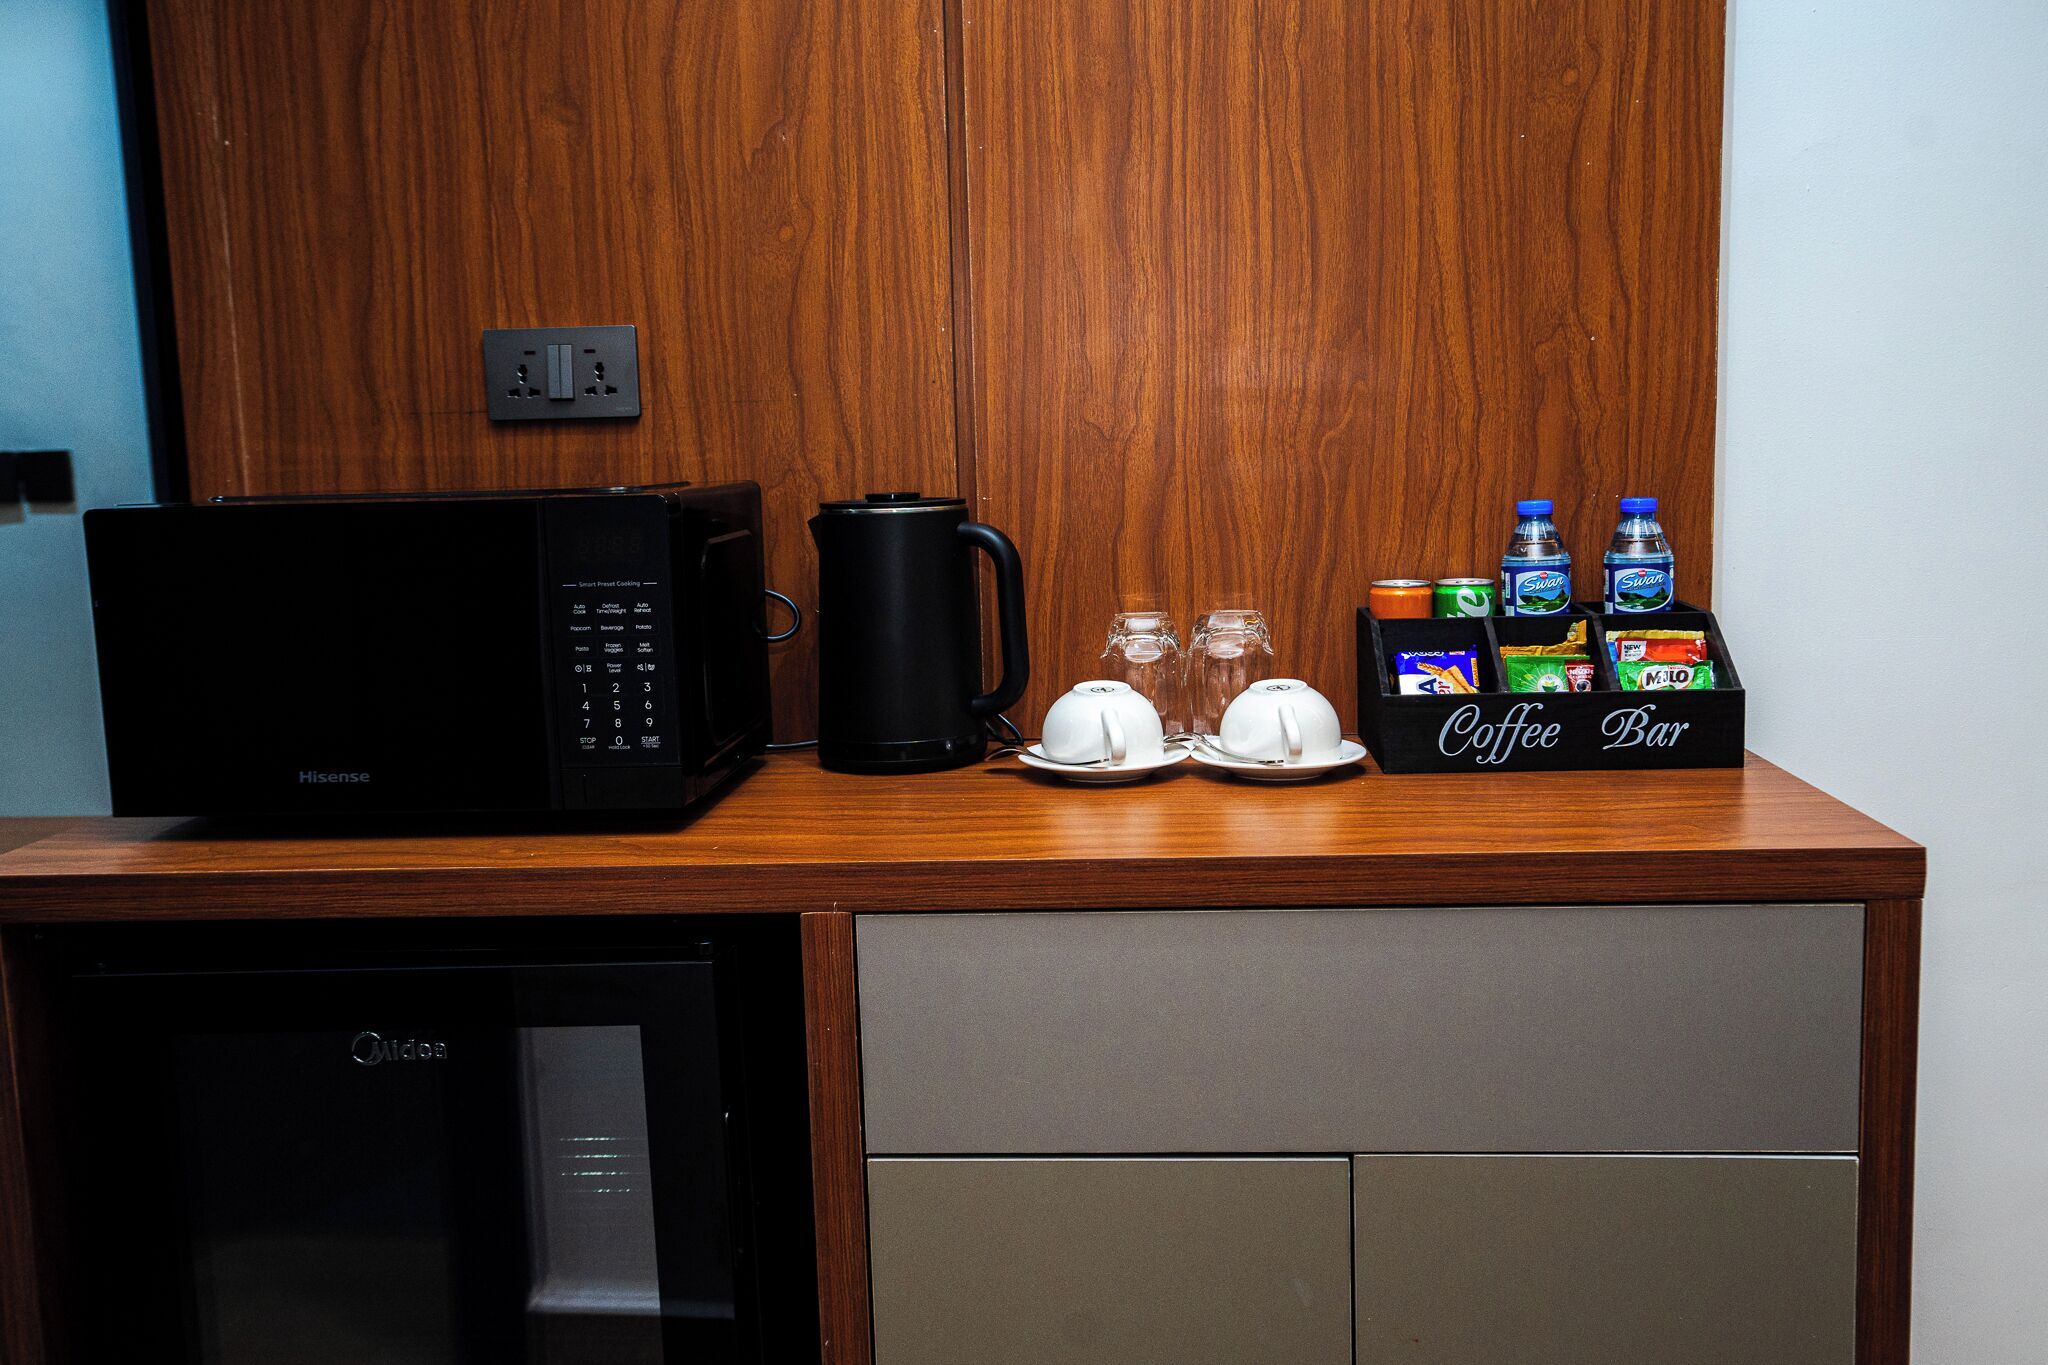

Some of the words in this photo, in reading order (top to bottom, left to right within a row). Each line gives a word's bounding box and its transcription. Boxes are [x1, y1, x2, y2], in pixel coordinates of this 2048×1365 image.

[616, 580, 640, 588] Cooking
[1523, 576, 1564, 592] Swan
[1621, 573, 1664, 589] Swan
[582, 683, 587, 693] 1
[612, 682, 620, 693] 2
[644, 682, 651, 692] 3
[582, 701, 590, 711] 4
[613, 700, 621, 710] 5
[644, 700, 652, 710] 6
[583, 719, 590, 729] 7
[615, 718, 622, 728] 8
[645, 717, 653, 728] 9
[1438, 702, 1561, 764] Coffee
[1601, 703, 1690, 750] Bar
[615, 735, 623, 746] 0
[299, 770, 370, 783] Hisense
[352, 1031, 447, 1065] Midea
